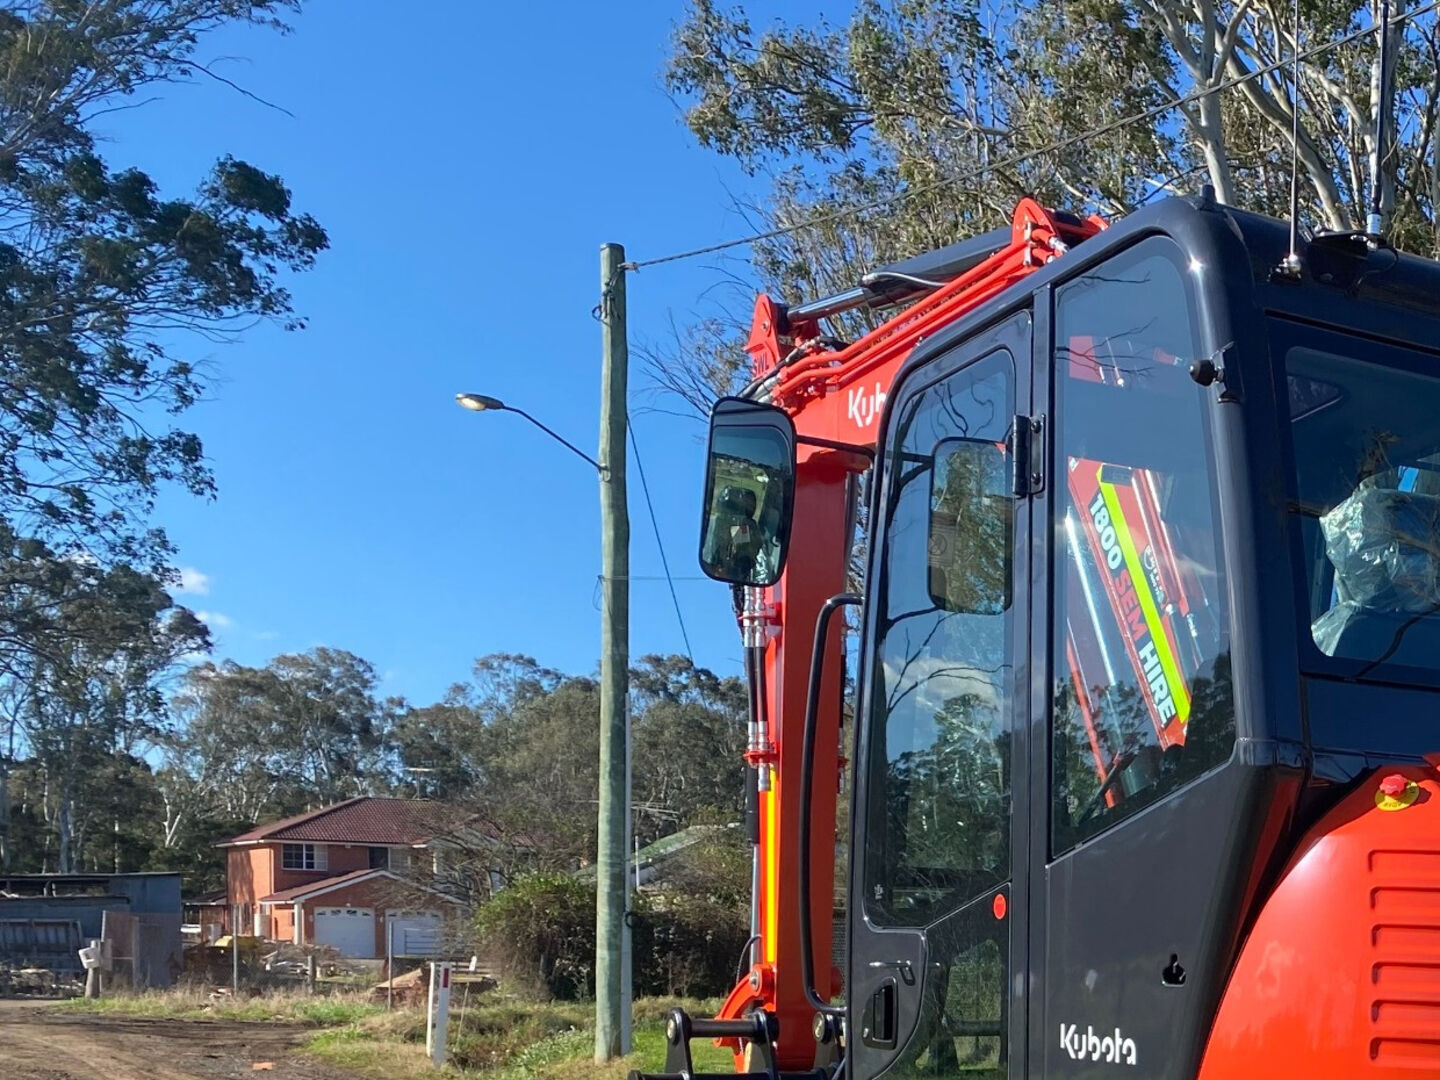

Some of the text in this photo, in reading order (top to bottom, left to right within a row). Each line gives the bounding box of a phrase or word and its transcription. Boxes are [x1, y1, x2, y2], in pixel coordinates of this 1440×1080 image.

[1090, 493, 1123, 570] 1800
[1113, 569, 1148, 642] SEM
[1139, 640, 1177, 728] HIRE
[1059, 1022, 1137, 1066] Kubota
